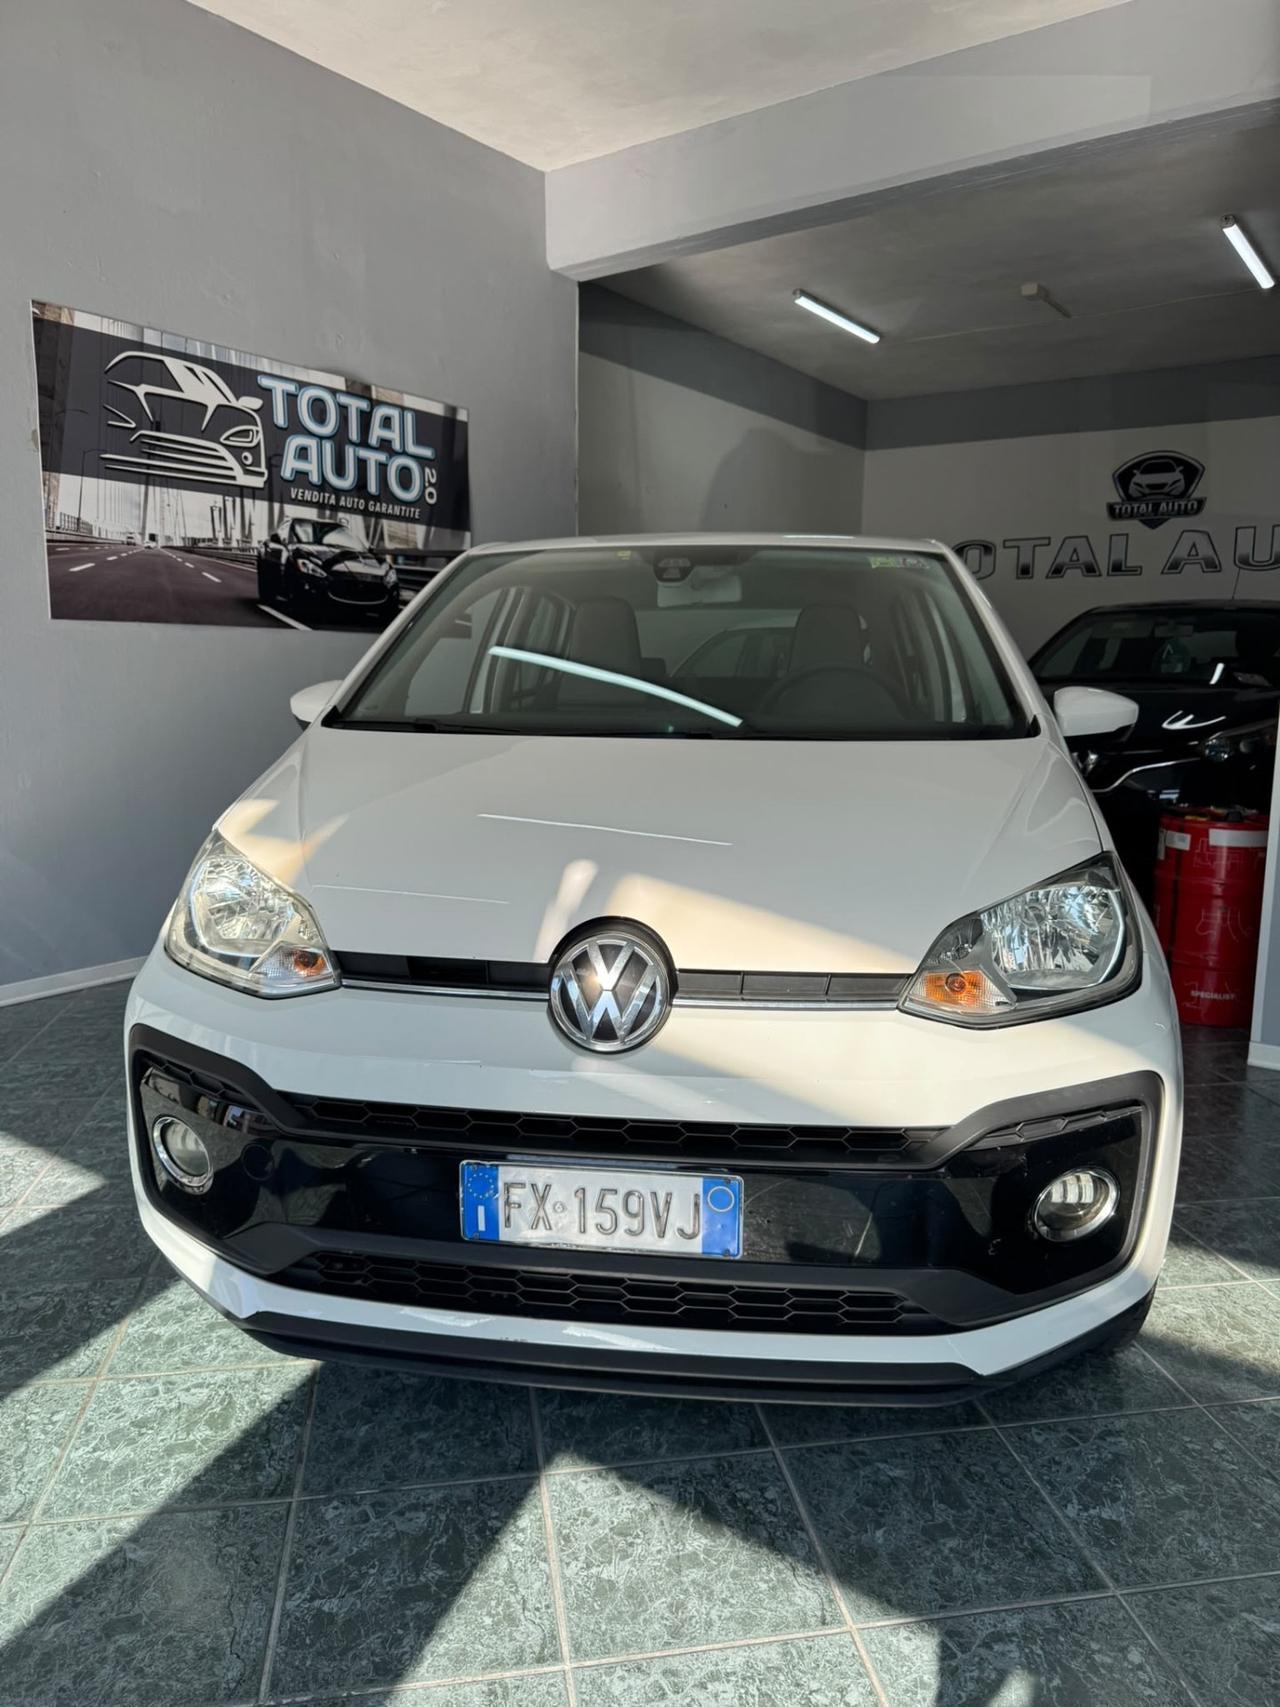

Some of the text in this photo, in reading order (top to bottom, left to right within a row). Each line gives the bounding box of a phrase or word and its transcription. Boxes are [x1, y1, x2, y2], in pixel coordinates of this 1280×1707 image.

[257, 374, 436, 460] TOTAL
[280, 434, 424, 501] AUTO
[424, 467, 437, 505] 2.0
[290, 487, 421, 519] VENDITA AUTO GARANTITE
[1113, 501, 1198, 515] TOTAL AUTO
[951, 534, 1142, 580] OTAL
